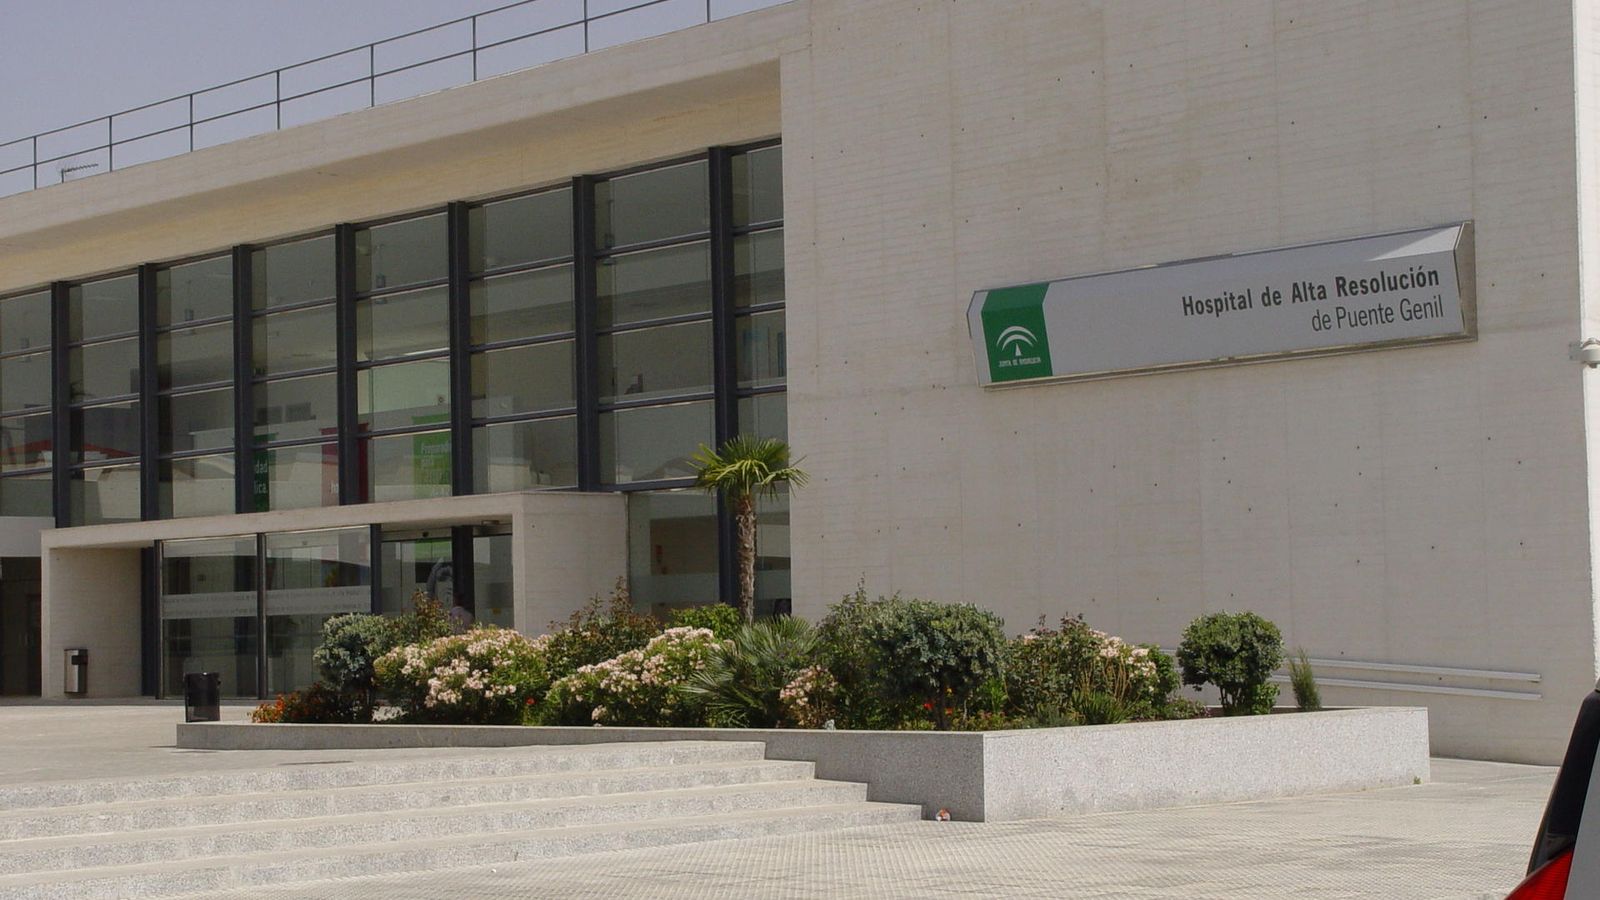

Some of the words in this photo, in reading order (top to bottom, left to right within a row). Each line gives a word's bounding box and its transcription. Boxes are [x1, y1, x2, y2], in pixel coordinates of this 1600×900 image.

[1182, 288, 1253, 318] Hospital
[1261, 286, 1282, 307] de
[1291, 281, 1327, 304] Alta
[1335, 266, 1440, 298] Resolución
[1311, 310, 1332, 332] de
[1337, 304, 1395, 329] Puente
[1400, 295, 1444, 322] Genil
